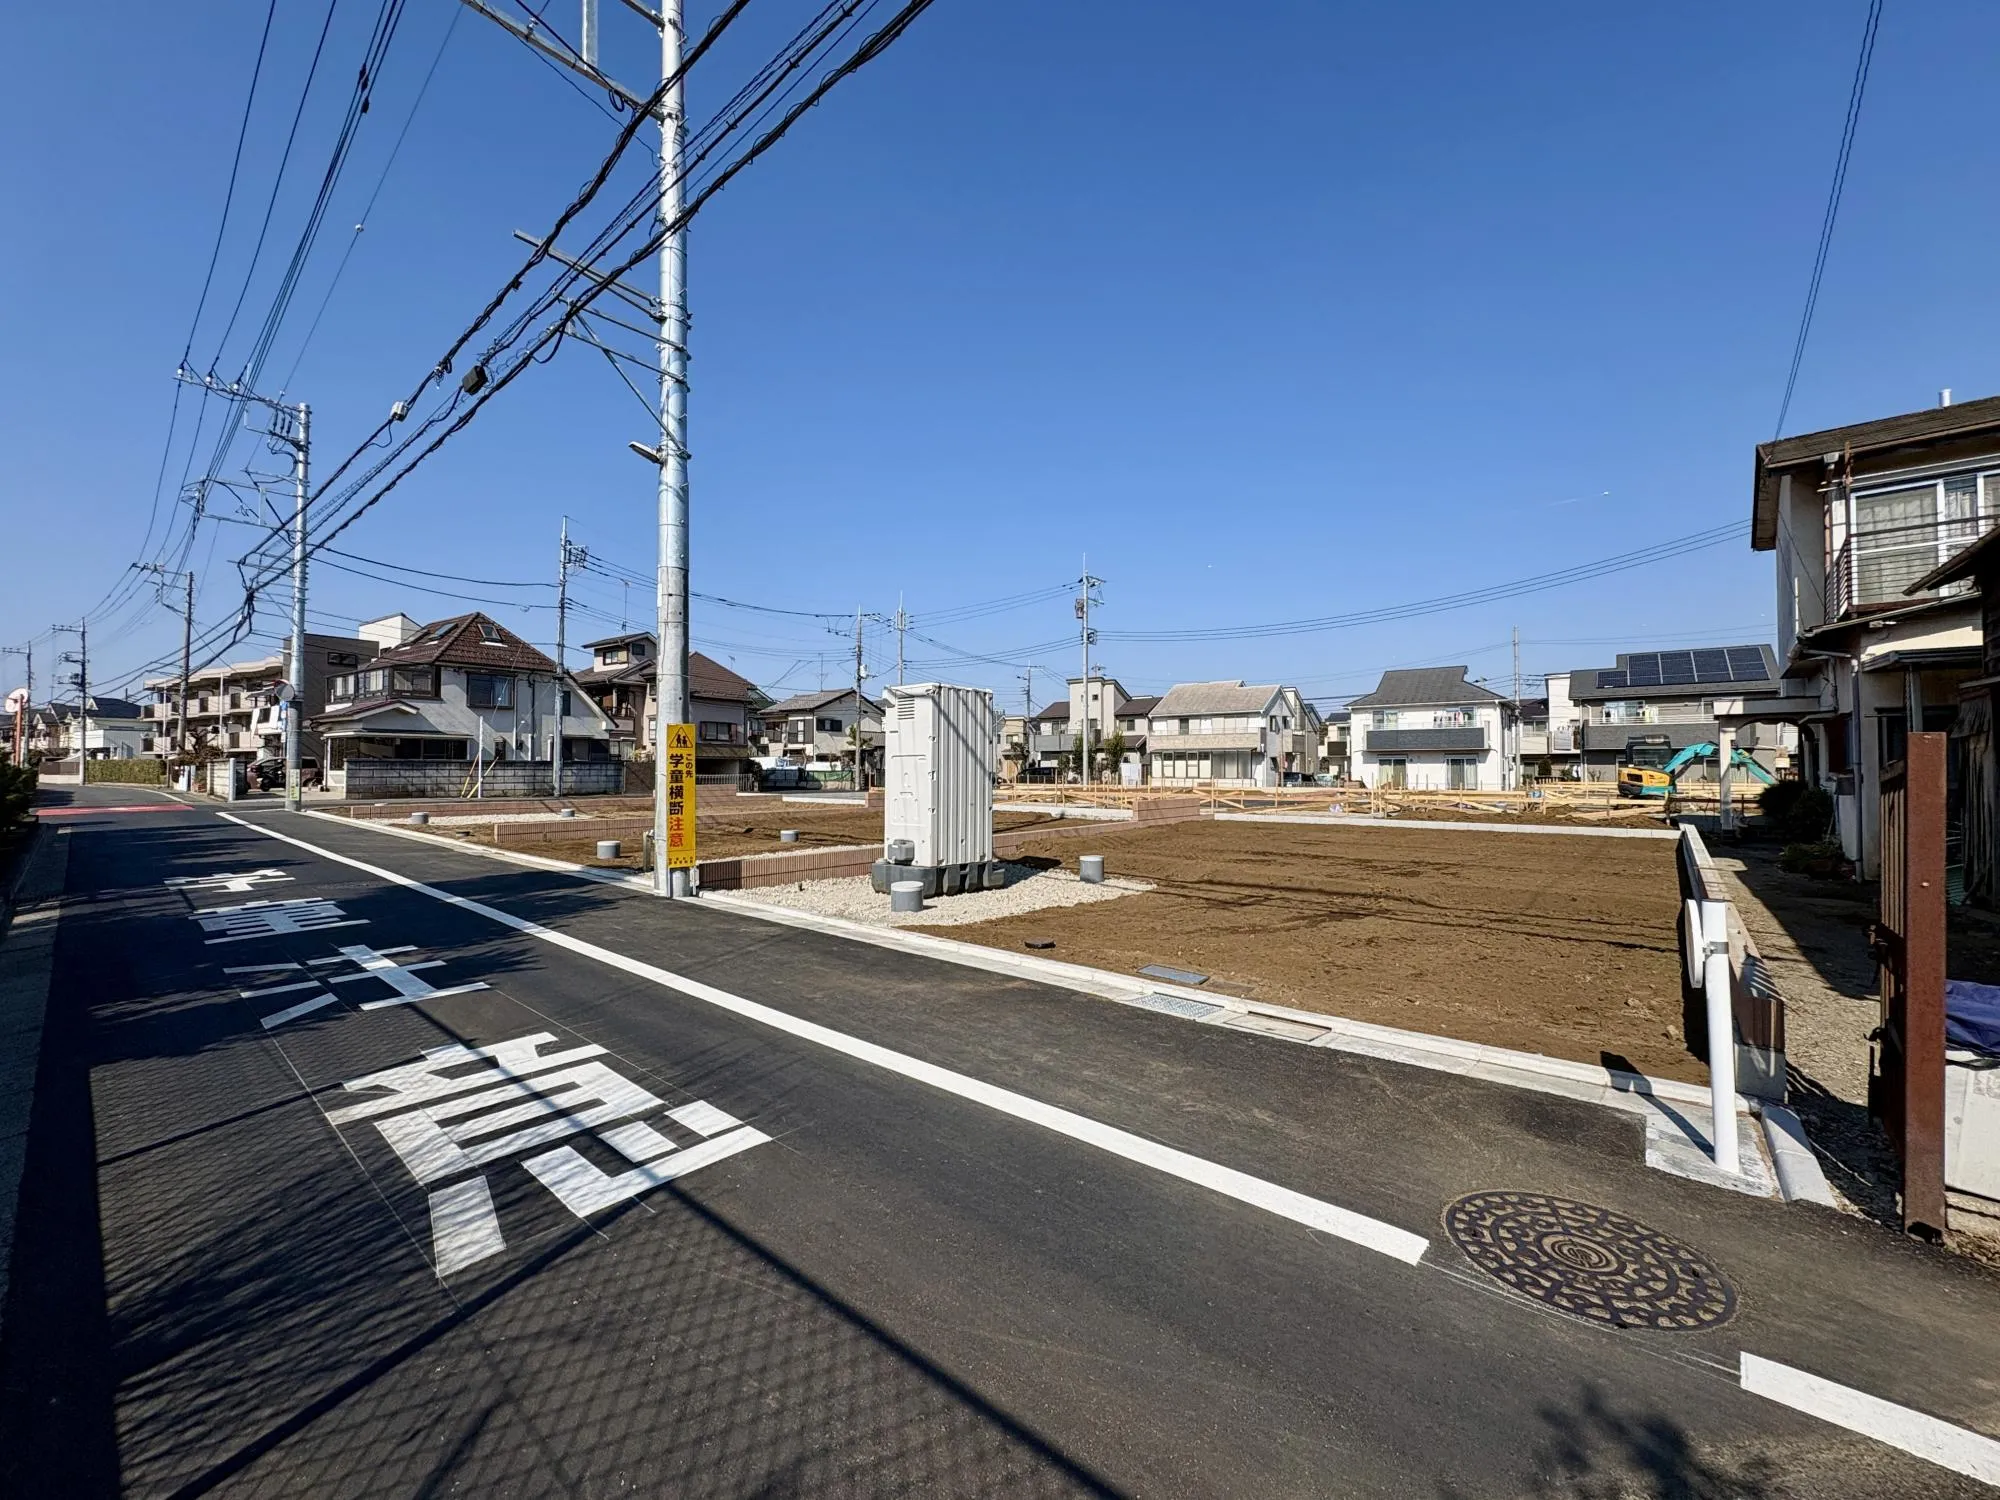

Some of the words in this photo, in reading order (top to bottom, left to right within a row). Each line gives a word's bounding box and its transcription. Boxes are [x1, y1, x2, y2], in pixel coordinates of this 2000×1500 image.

[669, 753, 684, 848] 学童横断注意
[685, 753, 694, 778] この先
[163, 868, 772, 1278] 学童注意
